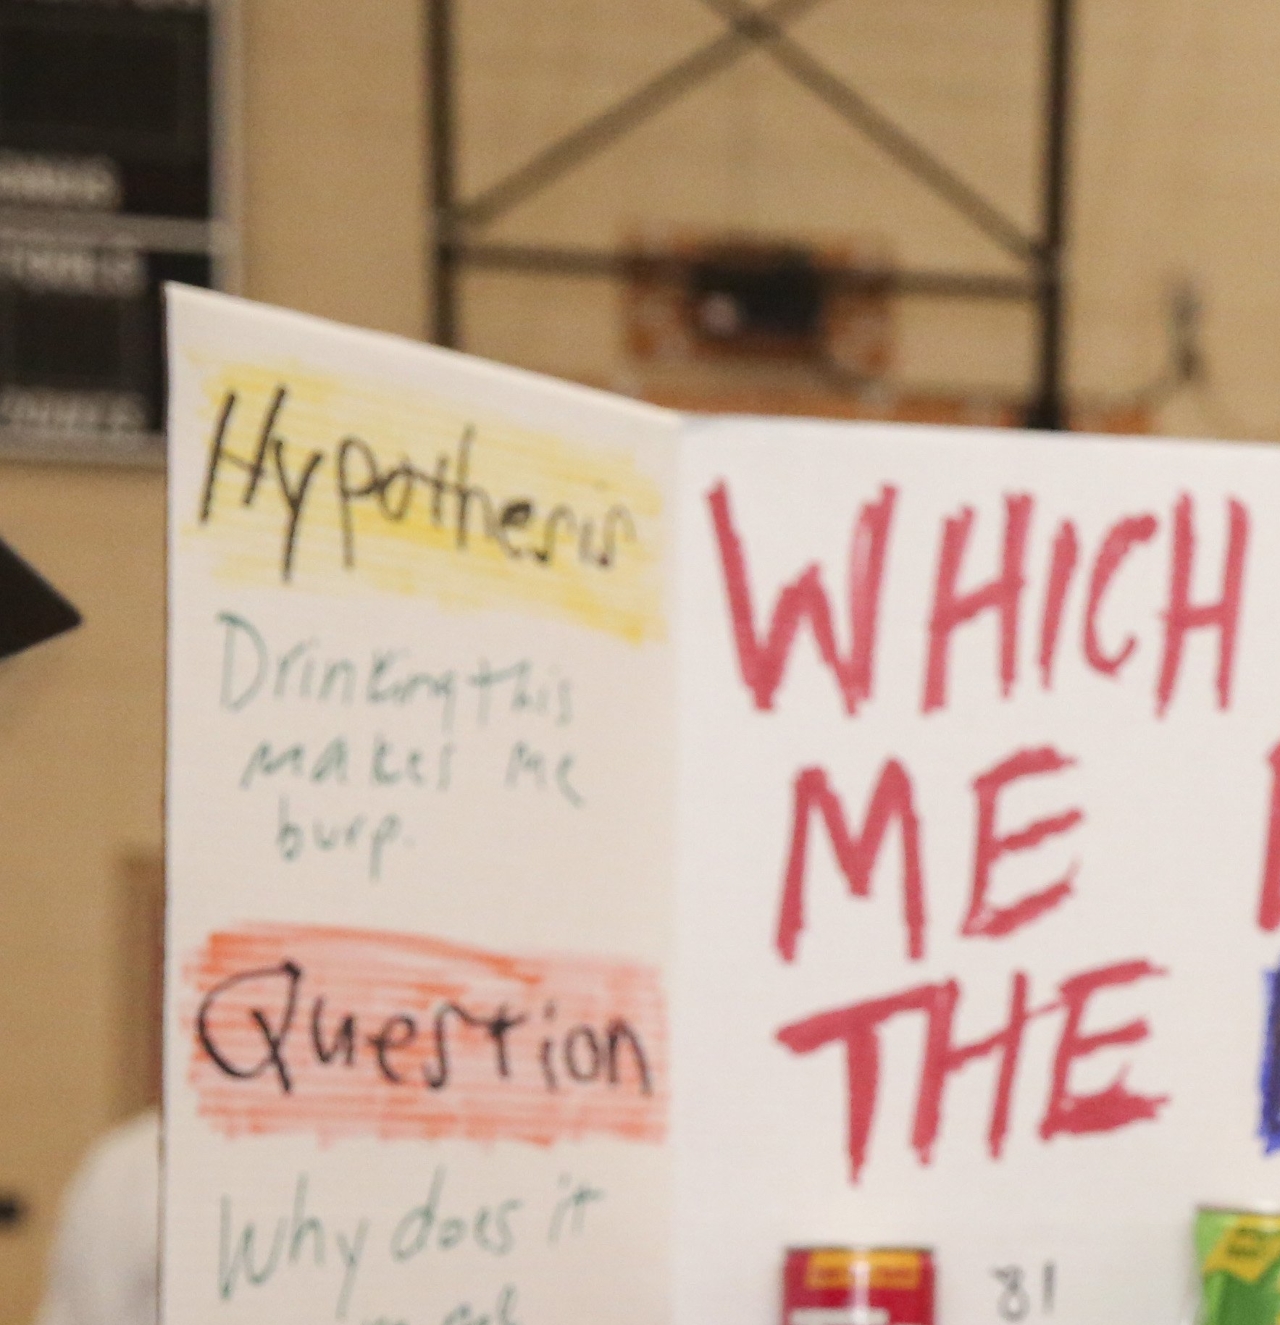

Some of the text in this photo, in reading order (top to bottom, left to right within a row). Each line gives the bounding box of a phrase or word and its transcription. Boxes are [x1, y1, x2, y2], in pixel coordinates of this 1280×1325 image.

[200, 383, 637, 584] Hypothesis
[706, 477, 1250, 720] WHICH
[774, 744, 1086, 964] ME
[196, 957, 653, 1094] Question
[774, 956, 1173, 1187] THE
[219, 1170, 371, 1322] Why
[391, 1166, 520, 1263] does
